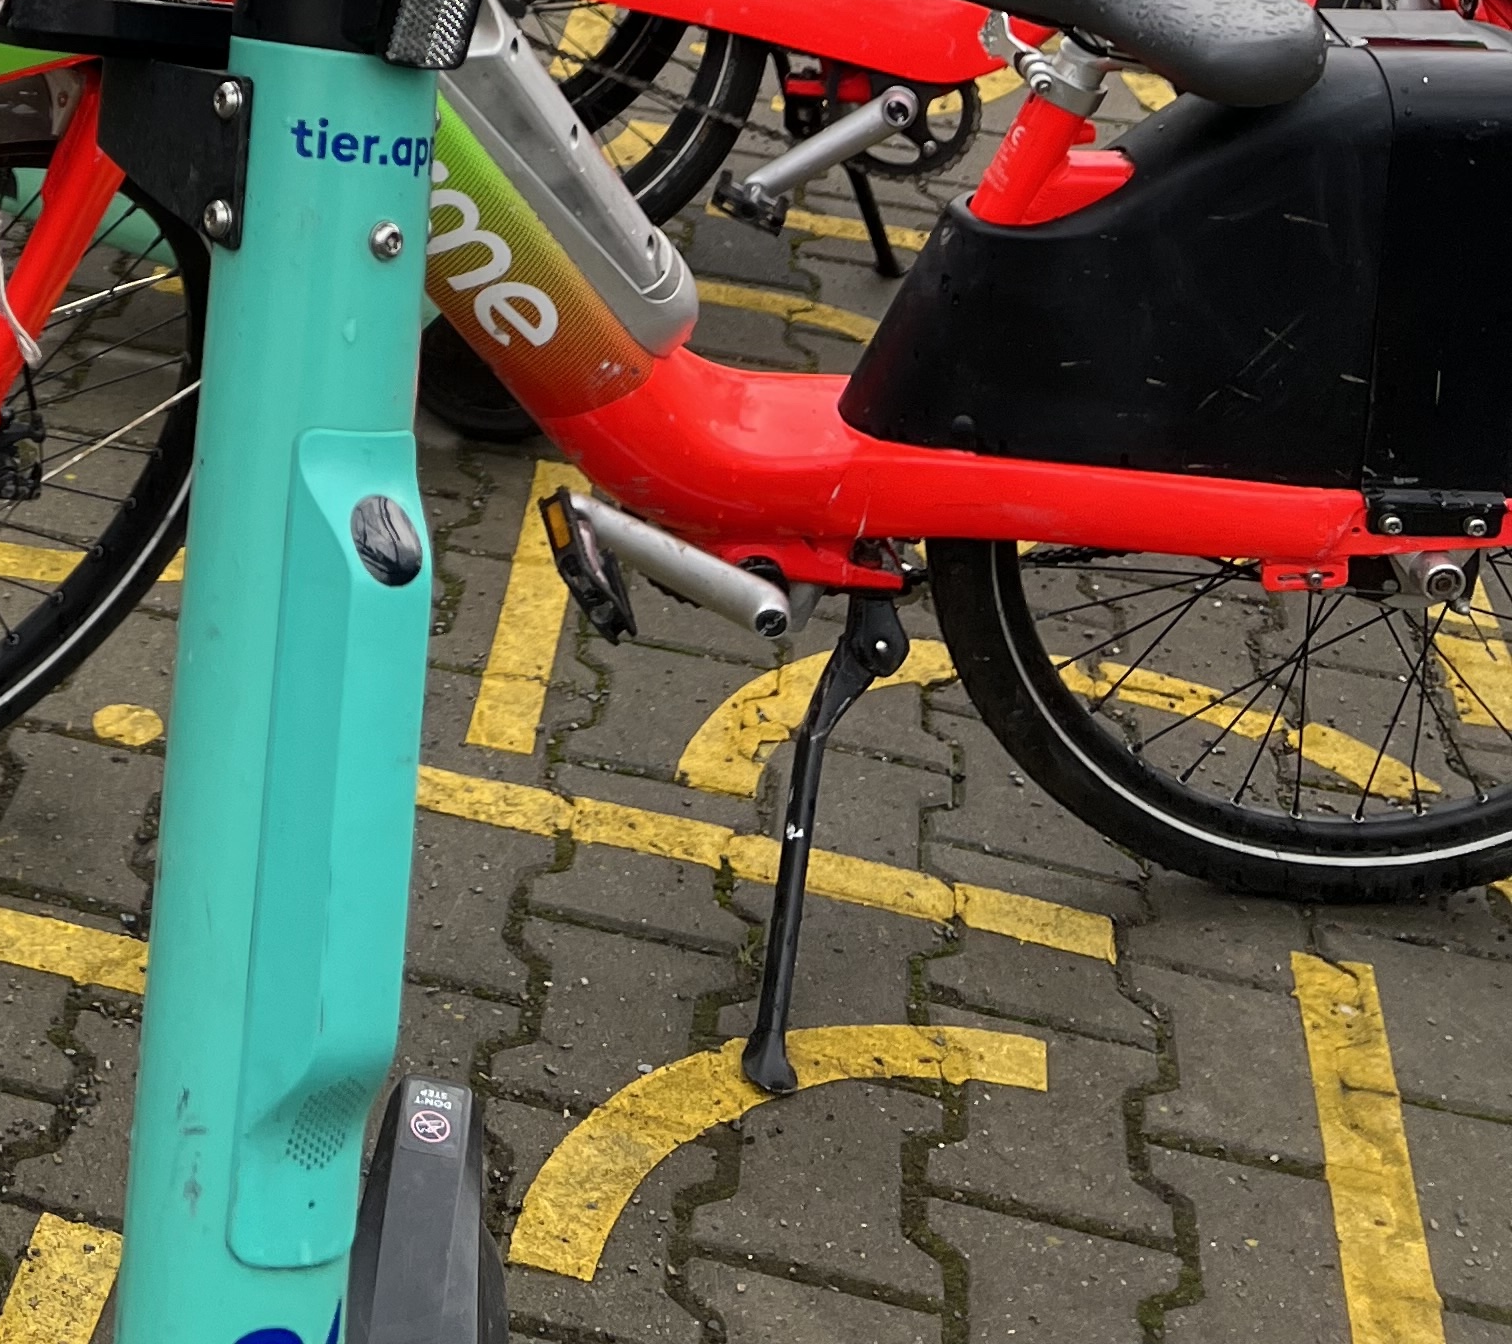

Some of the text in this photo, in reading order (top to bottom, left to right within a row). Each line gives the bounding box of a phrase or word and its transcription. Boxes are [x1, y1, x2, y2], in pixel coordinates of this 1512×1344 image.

[290, 118, 434, 177] tier.ap
[419, 1088, 449, 1100] STEP
[414, 1095, 452, 1110] DON'T
